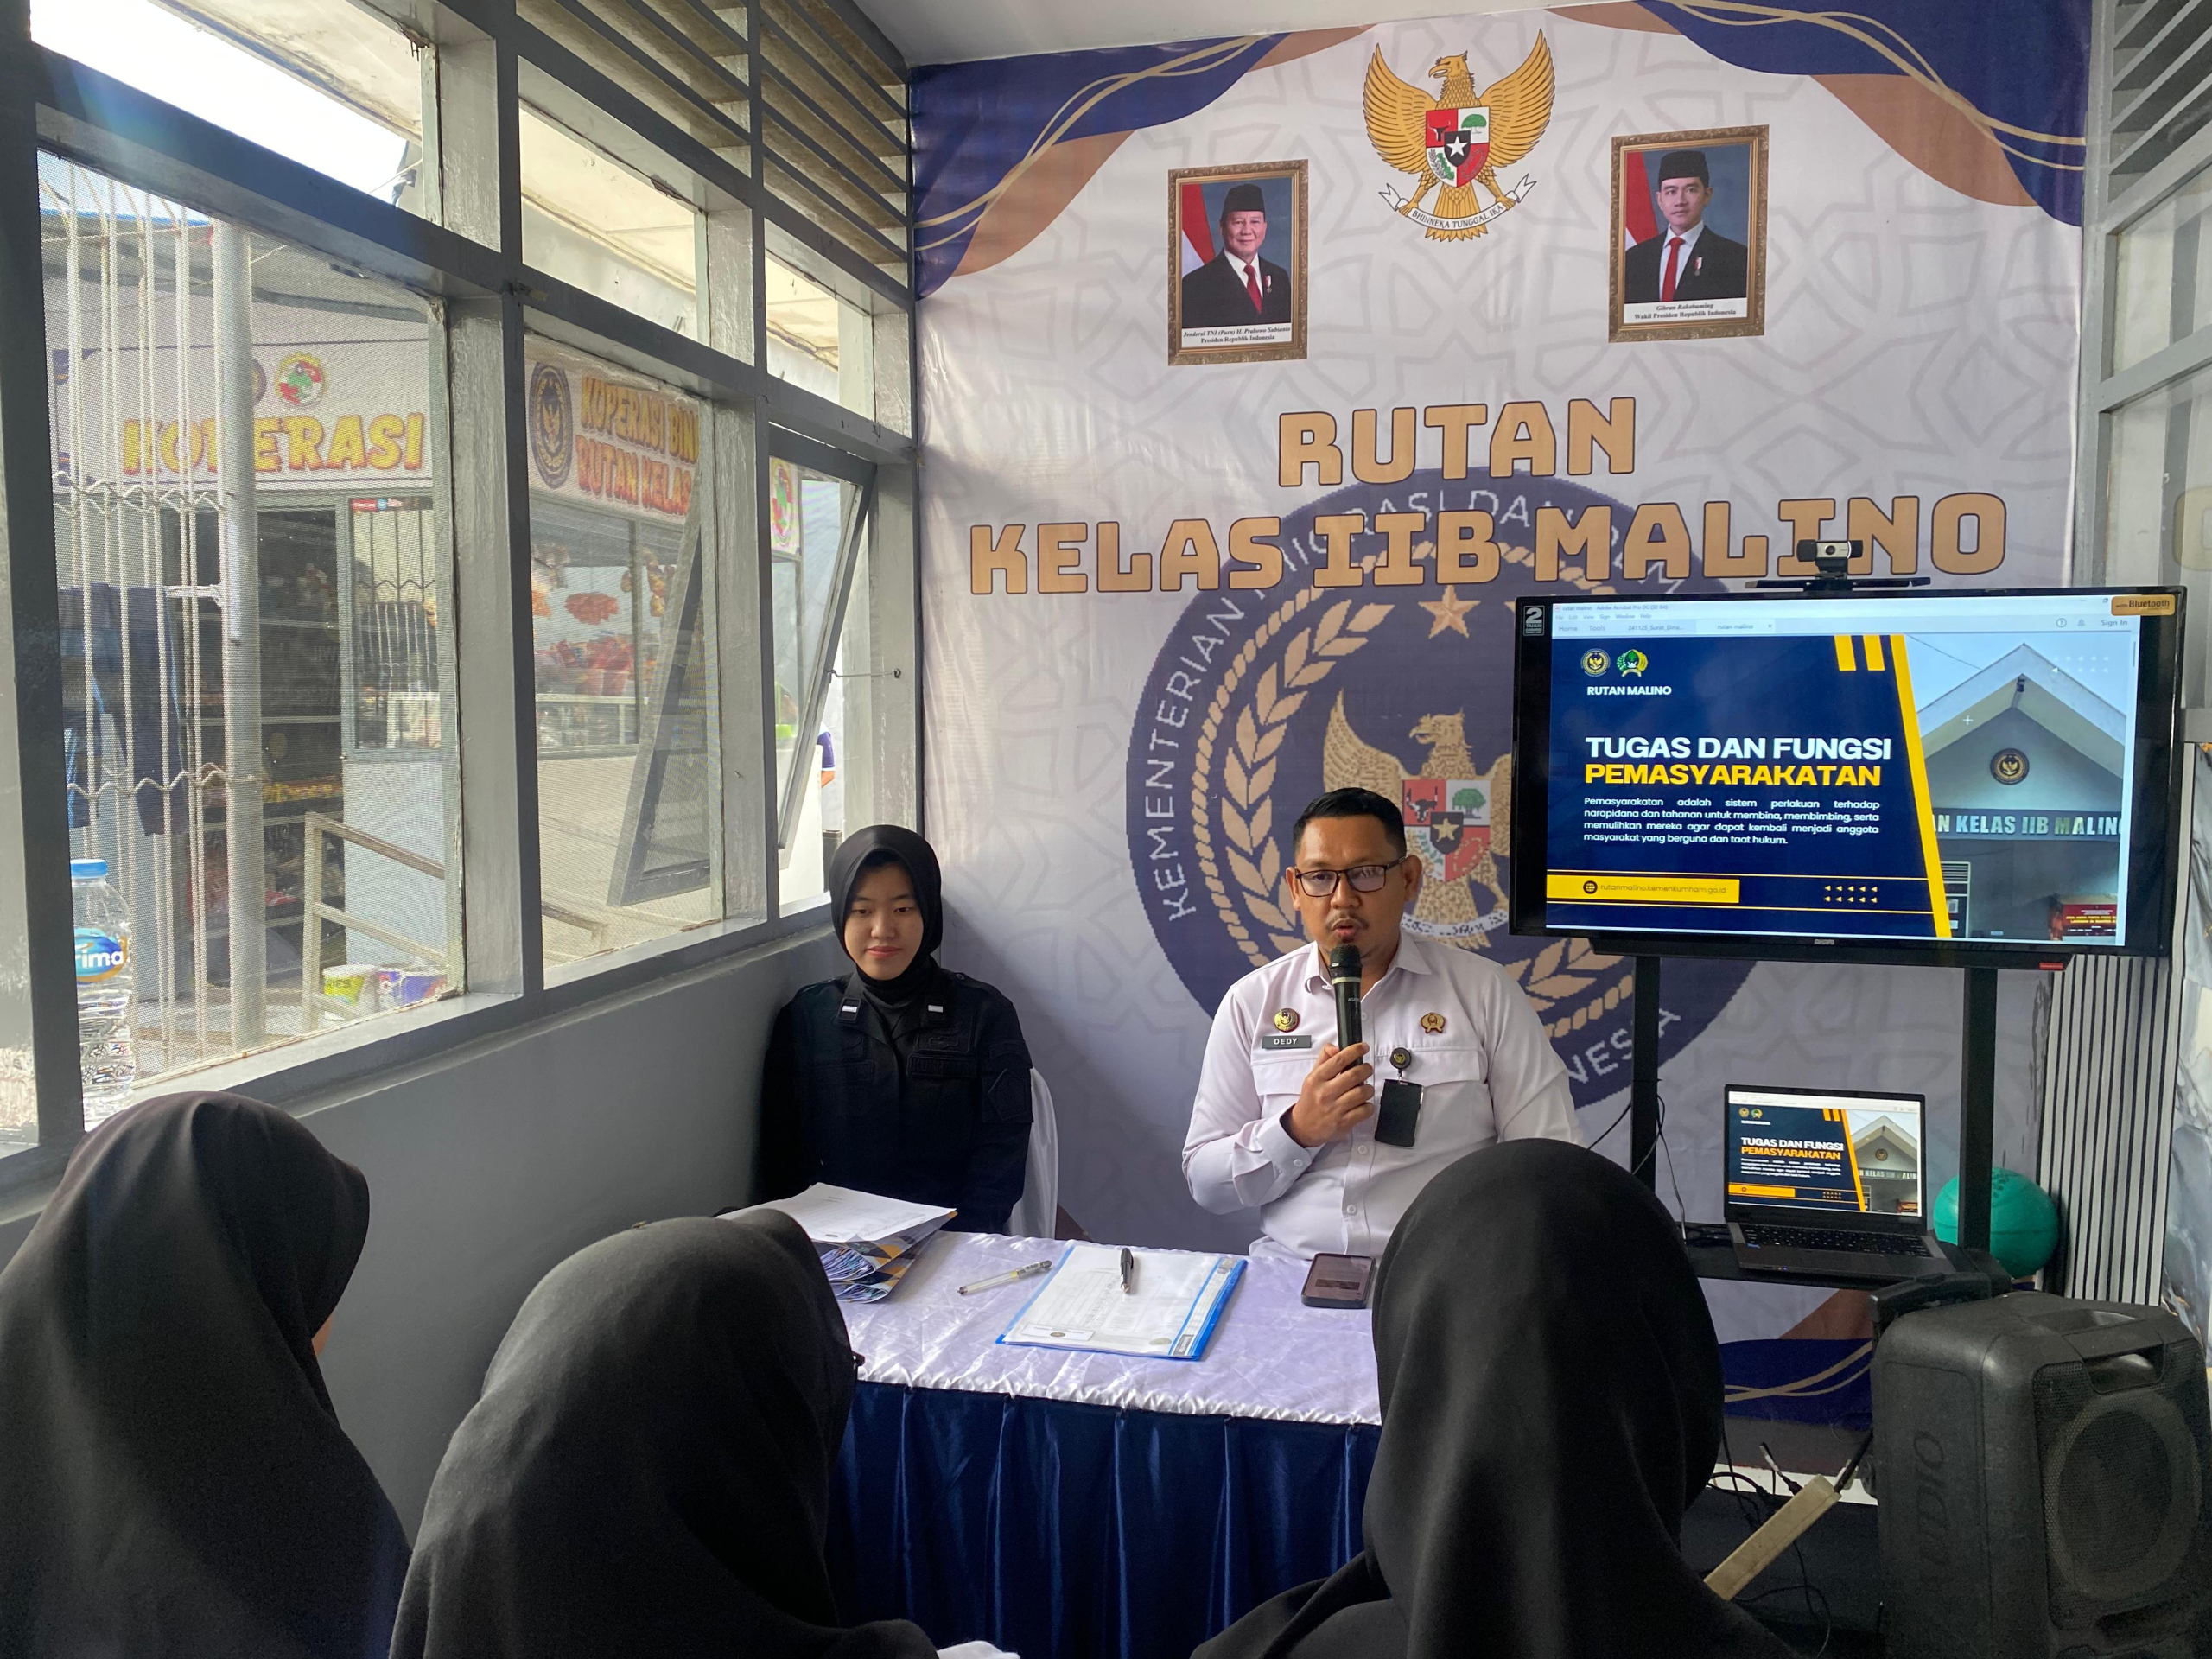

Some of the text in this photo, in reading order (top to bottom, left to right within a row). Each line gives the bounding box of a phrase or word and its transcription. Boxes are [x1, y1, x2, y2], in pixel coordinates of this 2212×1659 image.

[1412, 205, 1503, 229] BHINNEKA TUNGGAL IKA
[1279, 397, 1636, 487] RUTAN
[575, 434, 639, 505] RUTAN
[970, 516, 1284, 595] KELAS
[1313, 509, 1501, 589] IIB
[1533, 492, 2007, 582] MALINO
[2129, 600, 2170, 608] Bluetooth
[1526, 607, 1543, 624] 2
[1586, 685, 1673, 696] RUTAN MALINO
[1586, 736, 1892, 760] TUGAS DAN FUNGSI
[1146, 597, 1245, 922] KEMENTERIAN
[1585, 764, 1882, 786] PEMASYARAKATAN
[1584, 797, 1880, 810] Pemasyarakatan adalah sistem perlakuan terhadap
[1584, 809, 1639, 819] narapidana
[1641, 810, 1660, 818] dan
[1704, 810, 1732, 819] untuk
[1733, 810, 1783, 821] membina,
[1783, 811, 1853, 823] membimbing,
[1853, 813, 1880, 822] serta
[1583, 821, 1880, 836] memulihkan mereka agar dapat kembali menjadi anggota
[1955, 815, 2016, 835] KELAS
[2022, 816, 2049, 835] IIB
[1583, 834, 1640, 843] masyarakat
[1641, 835, 1666, 844] yang
[1667, 834, 1708, 845] berguna
[1752, 836, 1789, 844] hukum.
[1740, 1137, 1845, 1152] TUGAS DAN FUNGSI
[1740, 1146, 1841, 1160] PEMASYARAKATAN
